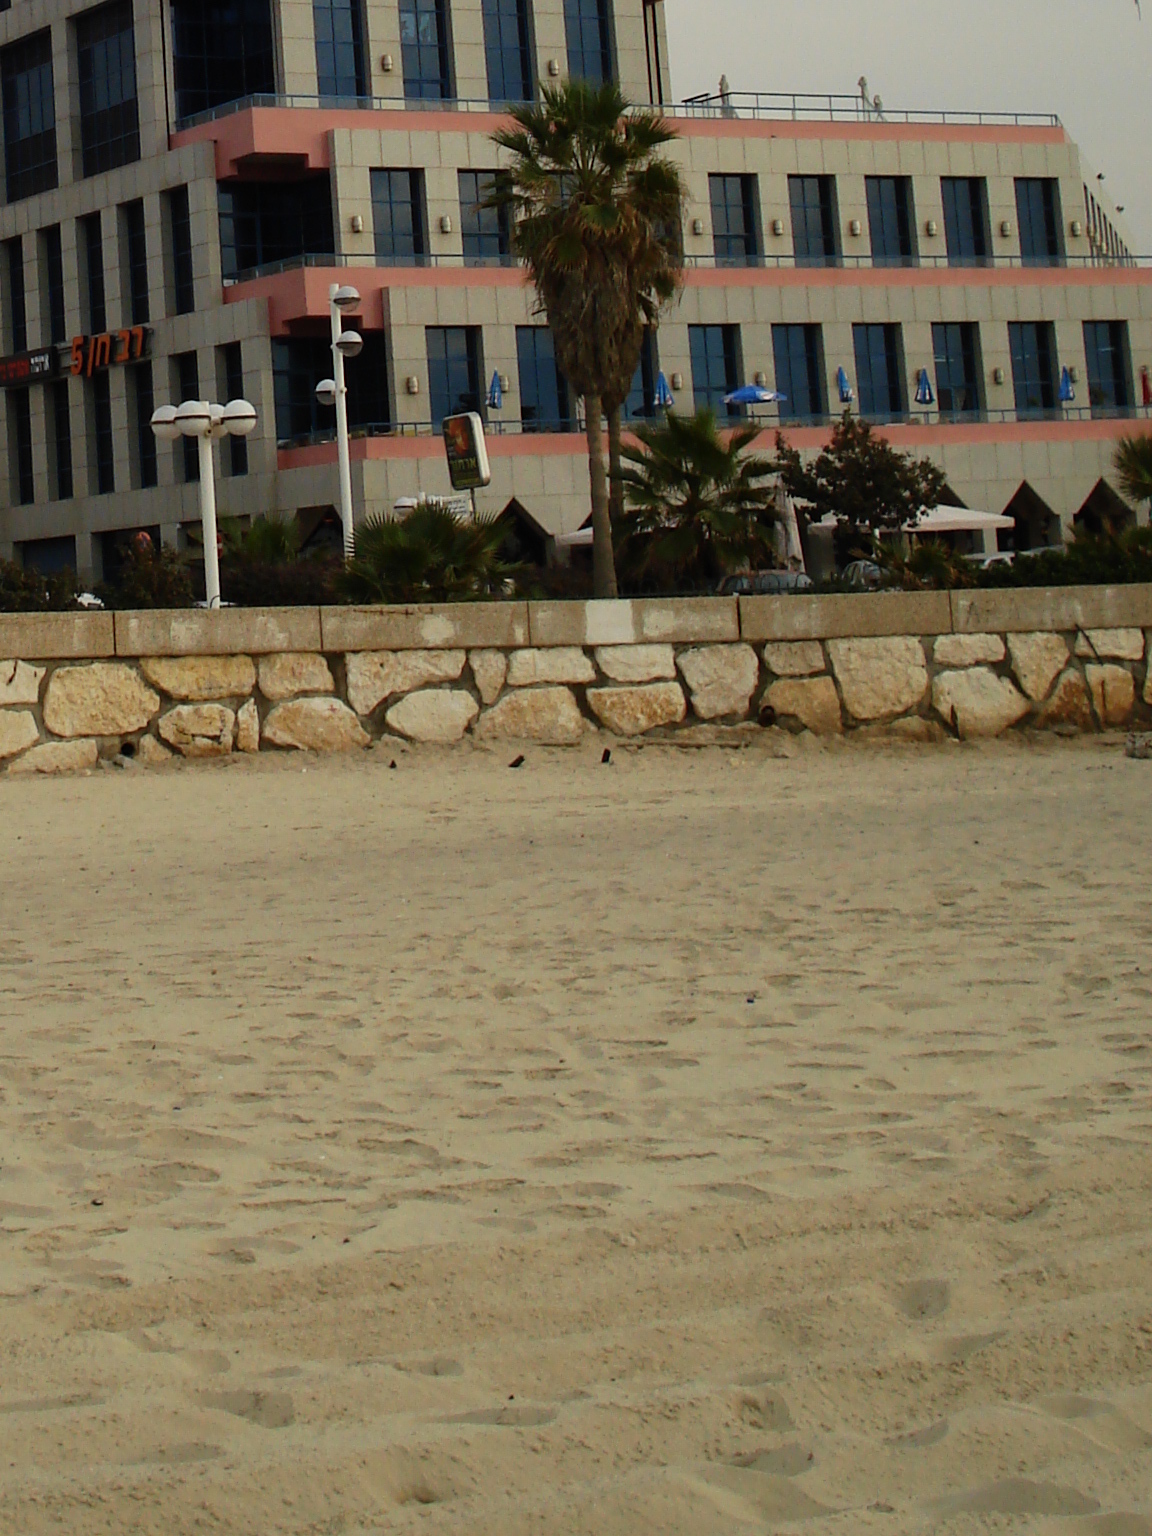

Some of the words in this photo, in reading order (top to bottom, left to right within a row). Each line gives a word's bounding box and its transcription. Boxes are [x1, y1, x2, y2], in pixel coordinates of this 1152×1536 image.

[70, 334, 84, 376] 5
[87, 334, 111, 378] חן
[116, 325, 144, 363] רב
